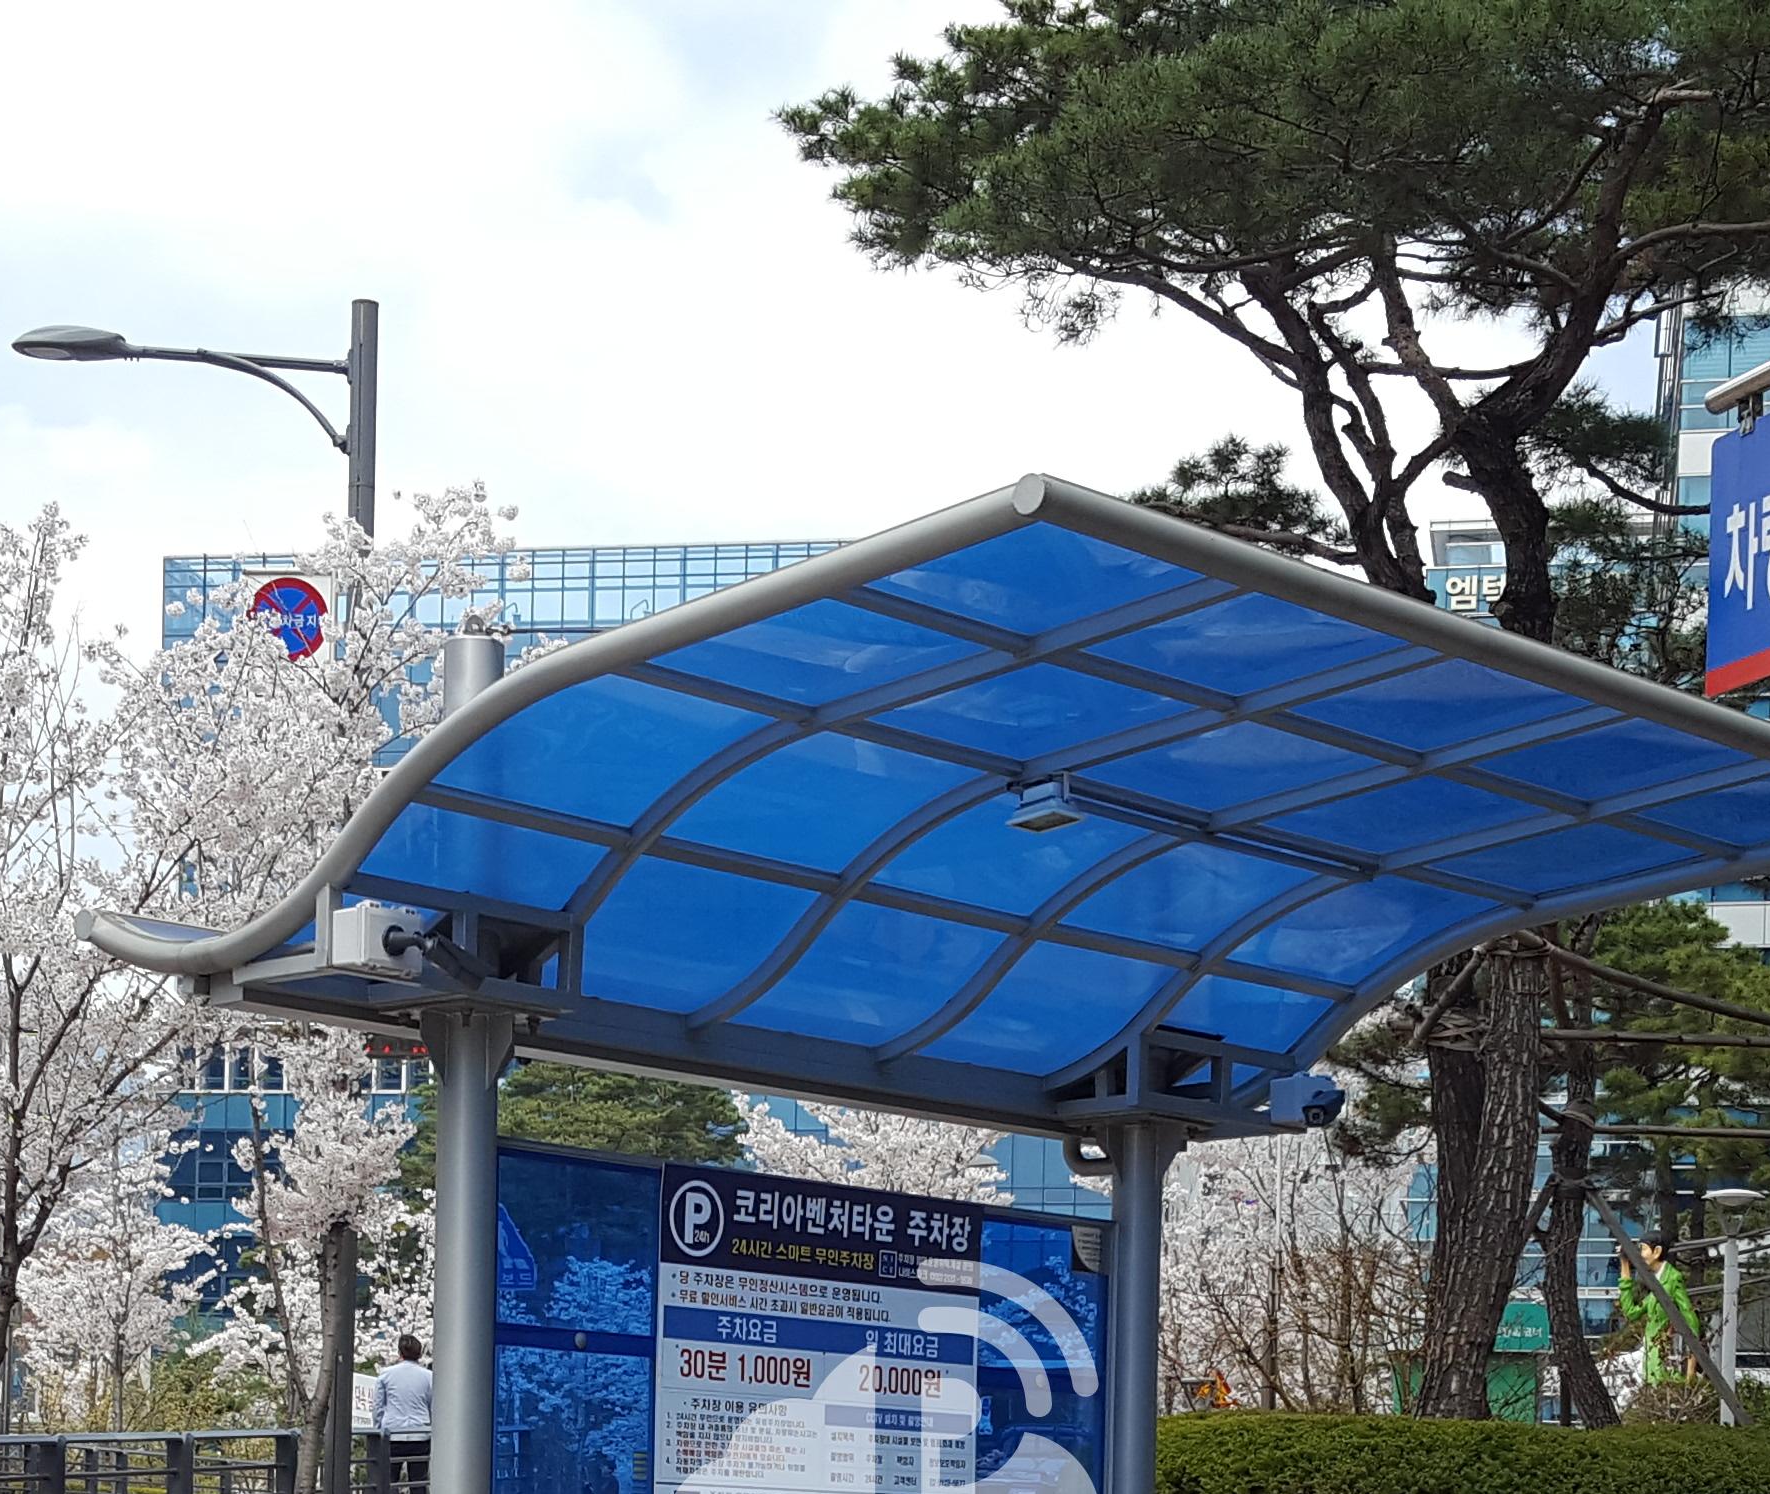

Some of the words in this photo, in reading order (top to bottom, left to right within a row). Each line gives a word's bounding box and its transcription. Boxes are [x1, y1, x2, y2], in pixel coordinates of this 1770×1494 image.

[684, 1191, 712, 1244] P
[733, 1189, 895, 1242] 코리아벤처타운
[906, 1210, 971, 1252] 주차장
[732, 1239, 774, 1259] 24시간
[775, 1243, 812, 1263] 스마트
[815, 1247, 875, 1270] 무인주차장
[679, 1271, 689, 1285] 당
[693, 1272, 735, 1289] 주차장은
[738, 1277, 827, 1299] 무인정산시스템으로
[679, 1289, 697, 1302] 무료
[701, 1292, 747, 1308] 할인서비스
[749, 1296, 768, 1311] 시간
[770, 1298, 797, 1314] 초과시
[717, 1316, 778, 1344] 주차요금
[865, 1330, 878, 1352] 일
[883, 1331, 939, 1359] 최대요금
[680, 1348, 727, 1382] 30분
[737, 1353, 812, 1389] 1,000원
[858, 1364, 942, 1399] 20,000원
[690, 1398, 721, 1412] 주차장
[724, 1401, 744, 1414] 이용
